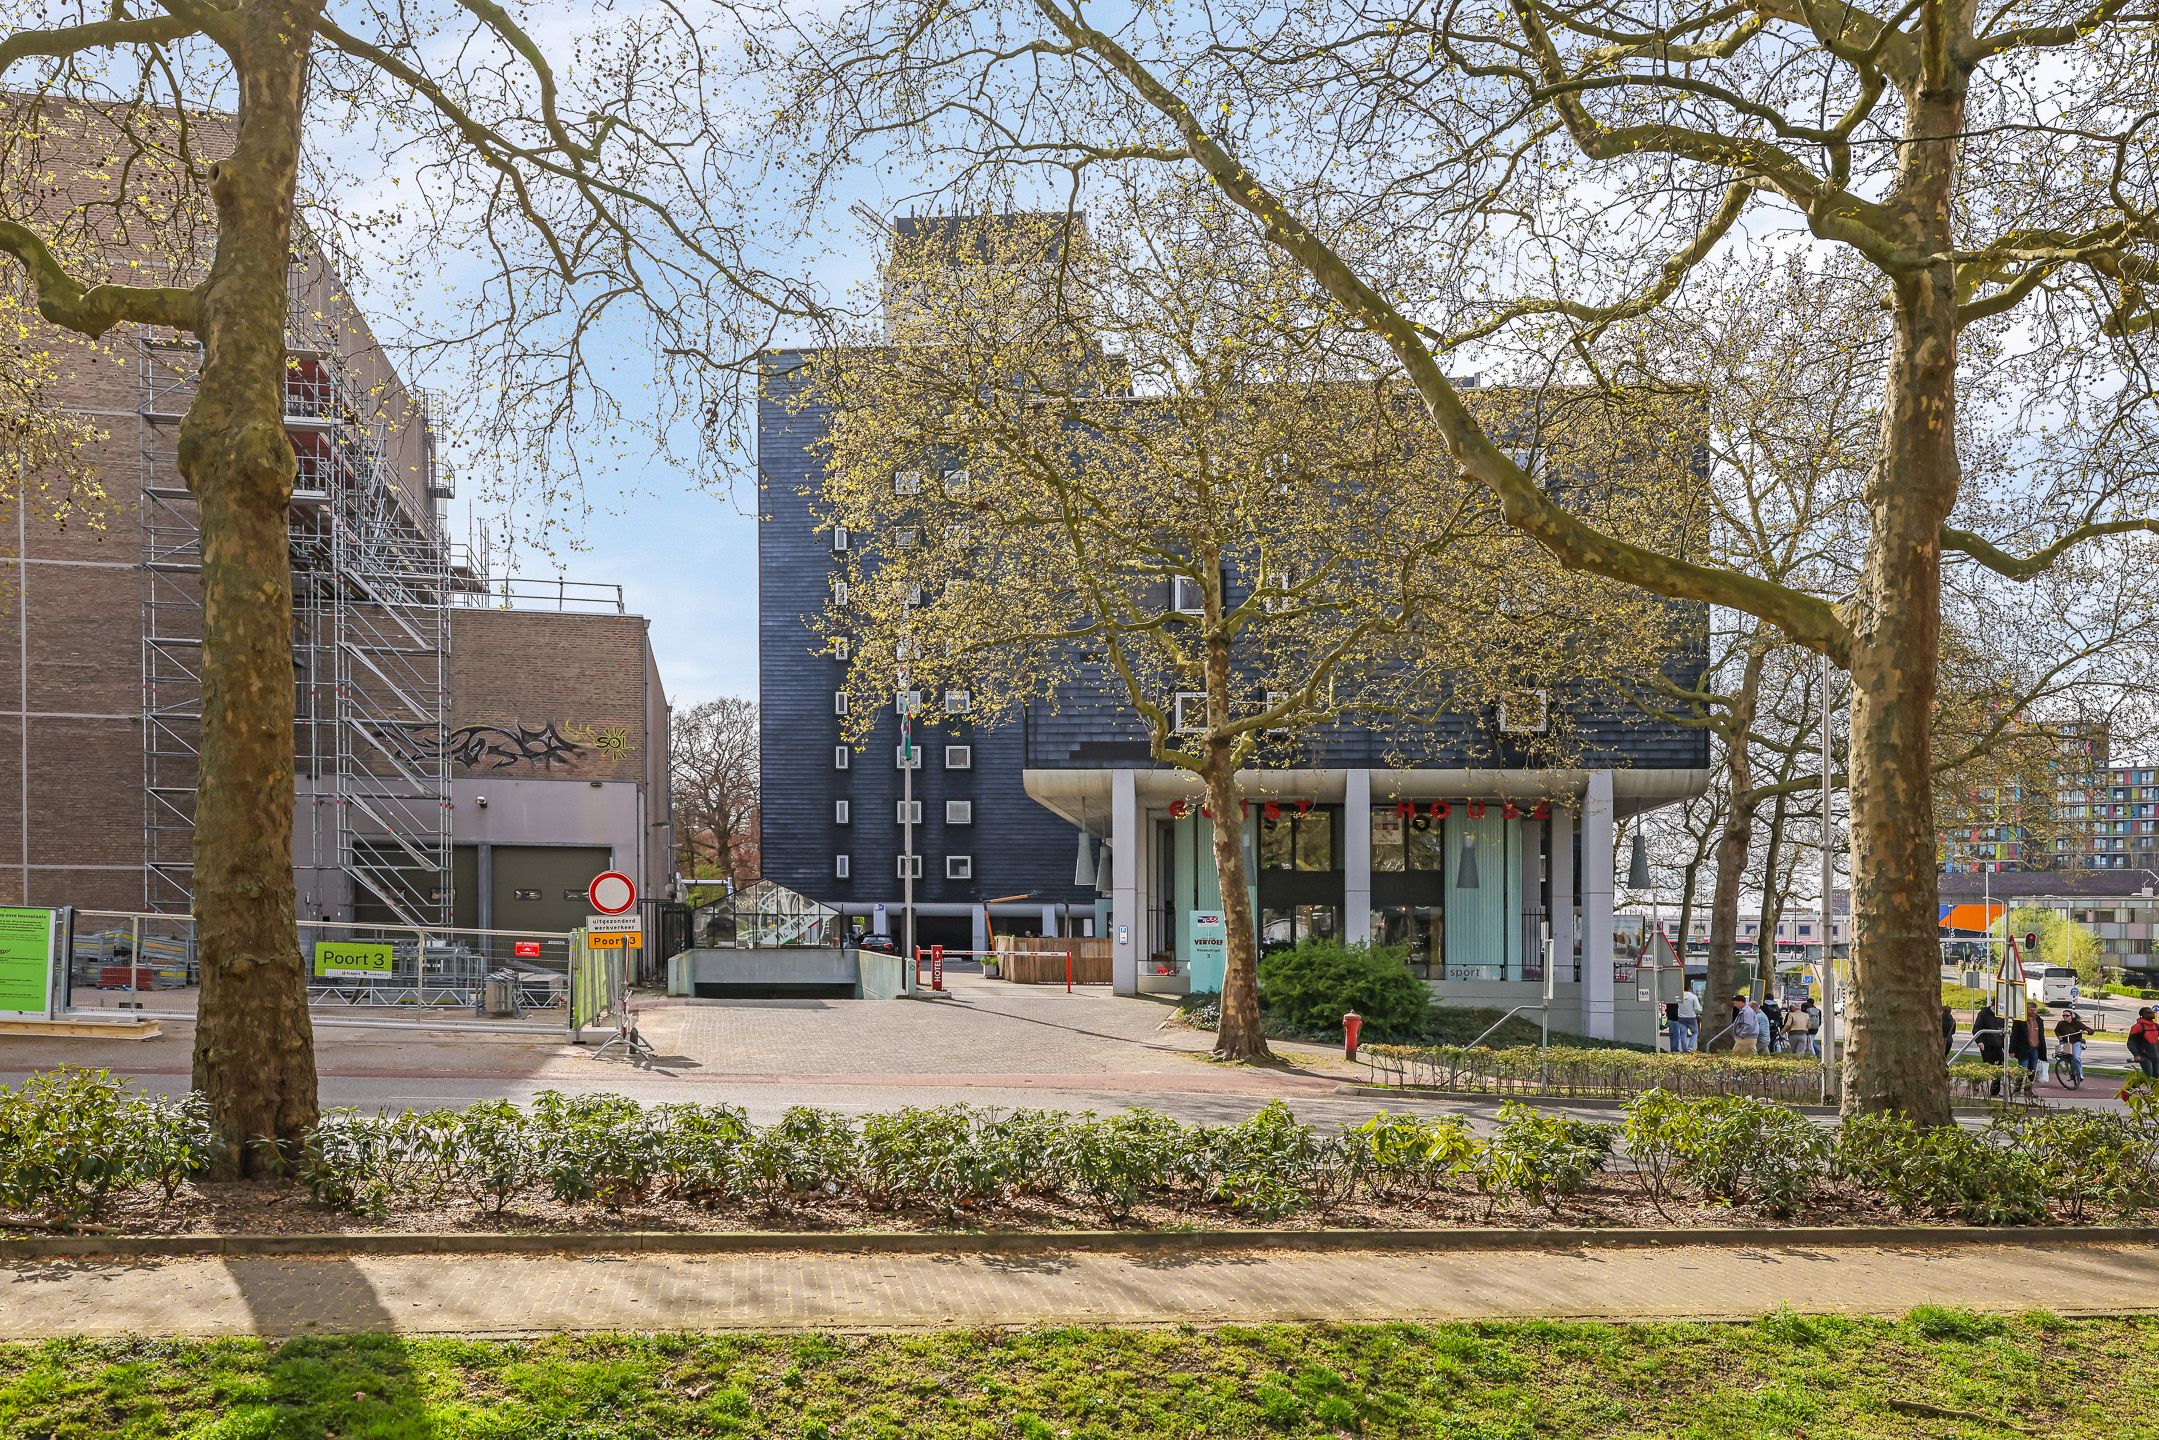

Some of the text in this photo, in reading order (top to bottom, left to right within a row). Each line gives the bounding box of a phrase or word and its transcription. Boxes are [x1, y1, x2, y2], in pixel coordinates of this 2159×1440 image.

[596, 735, 635, 751] SOL
[1396, 799, 1552, 820] HOUSE
[594, 936, 636, 945] Poor 3
[323, 951, 385, 968] Poort 3
[1449, 968, 1480, 978] sport
